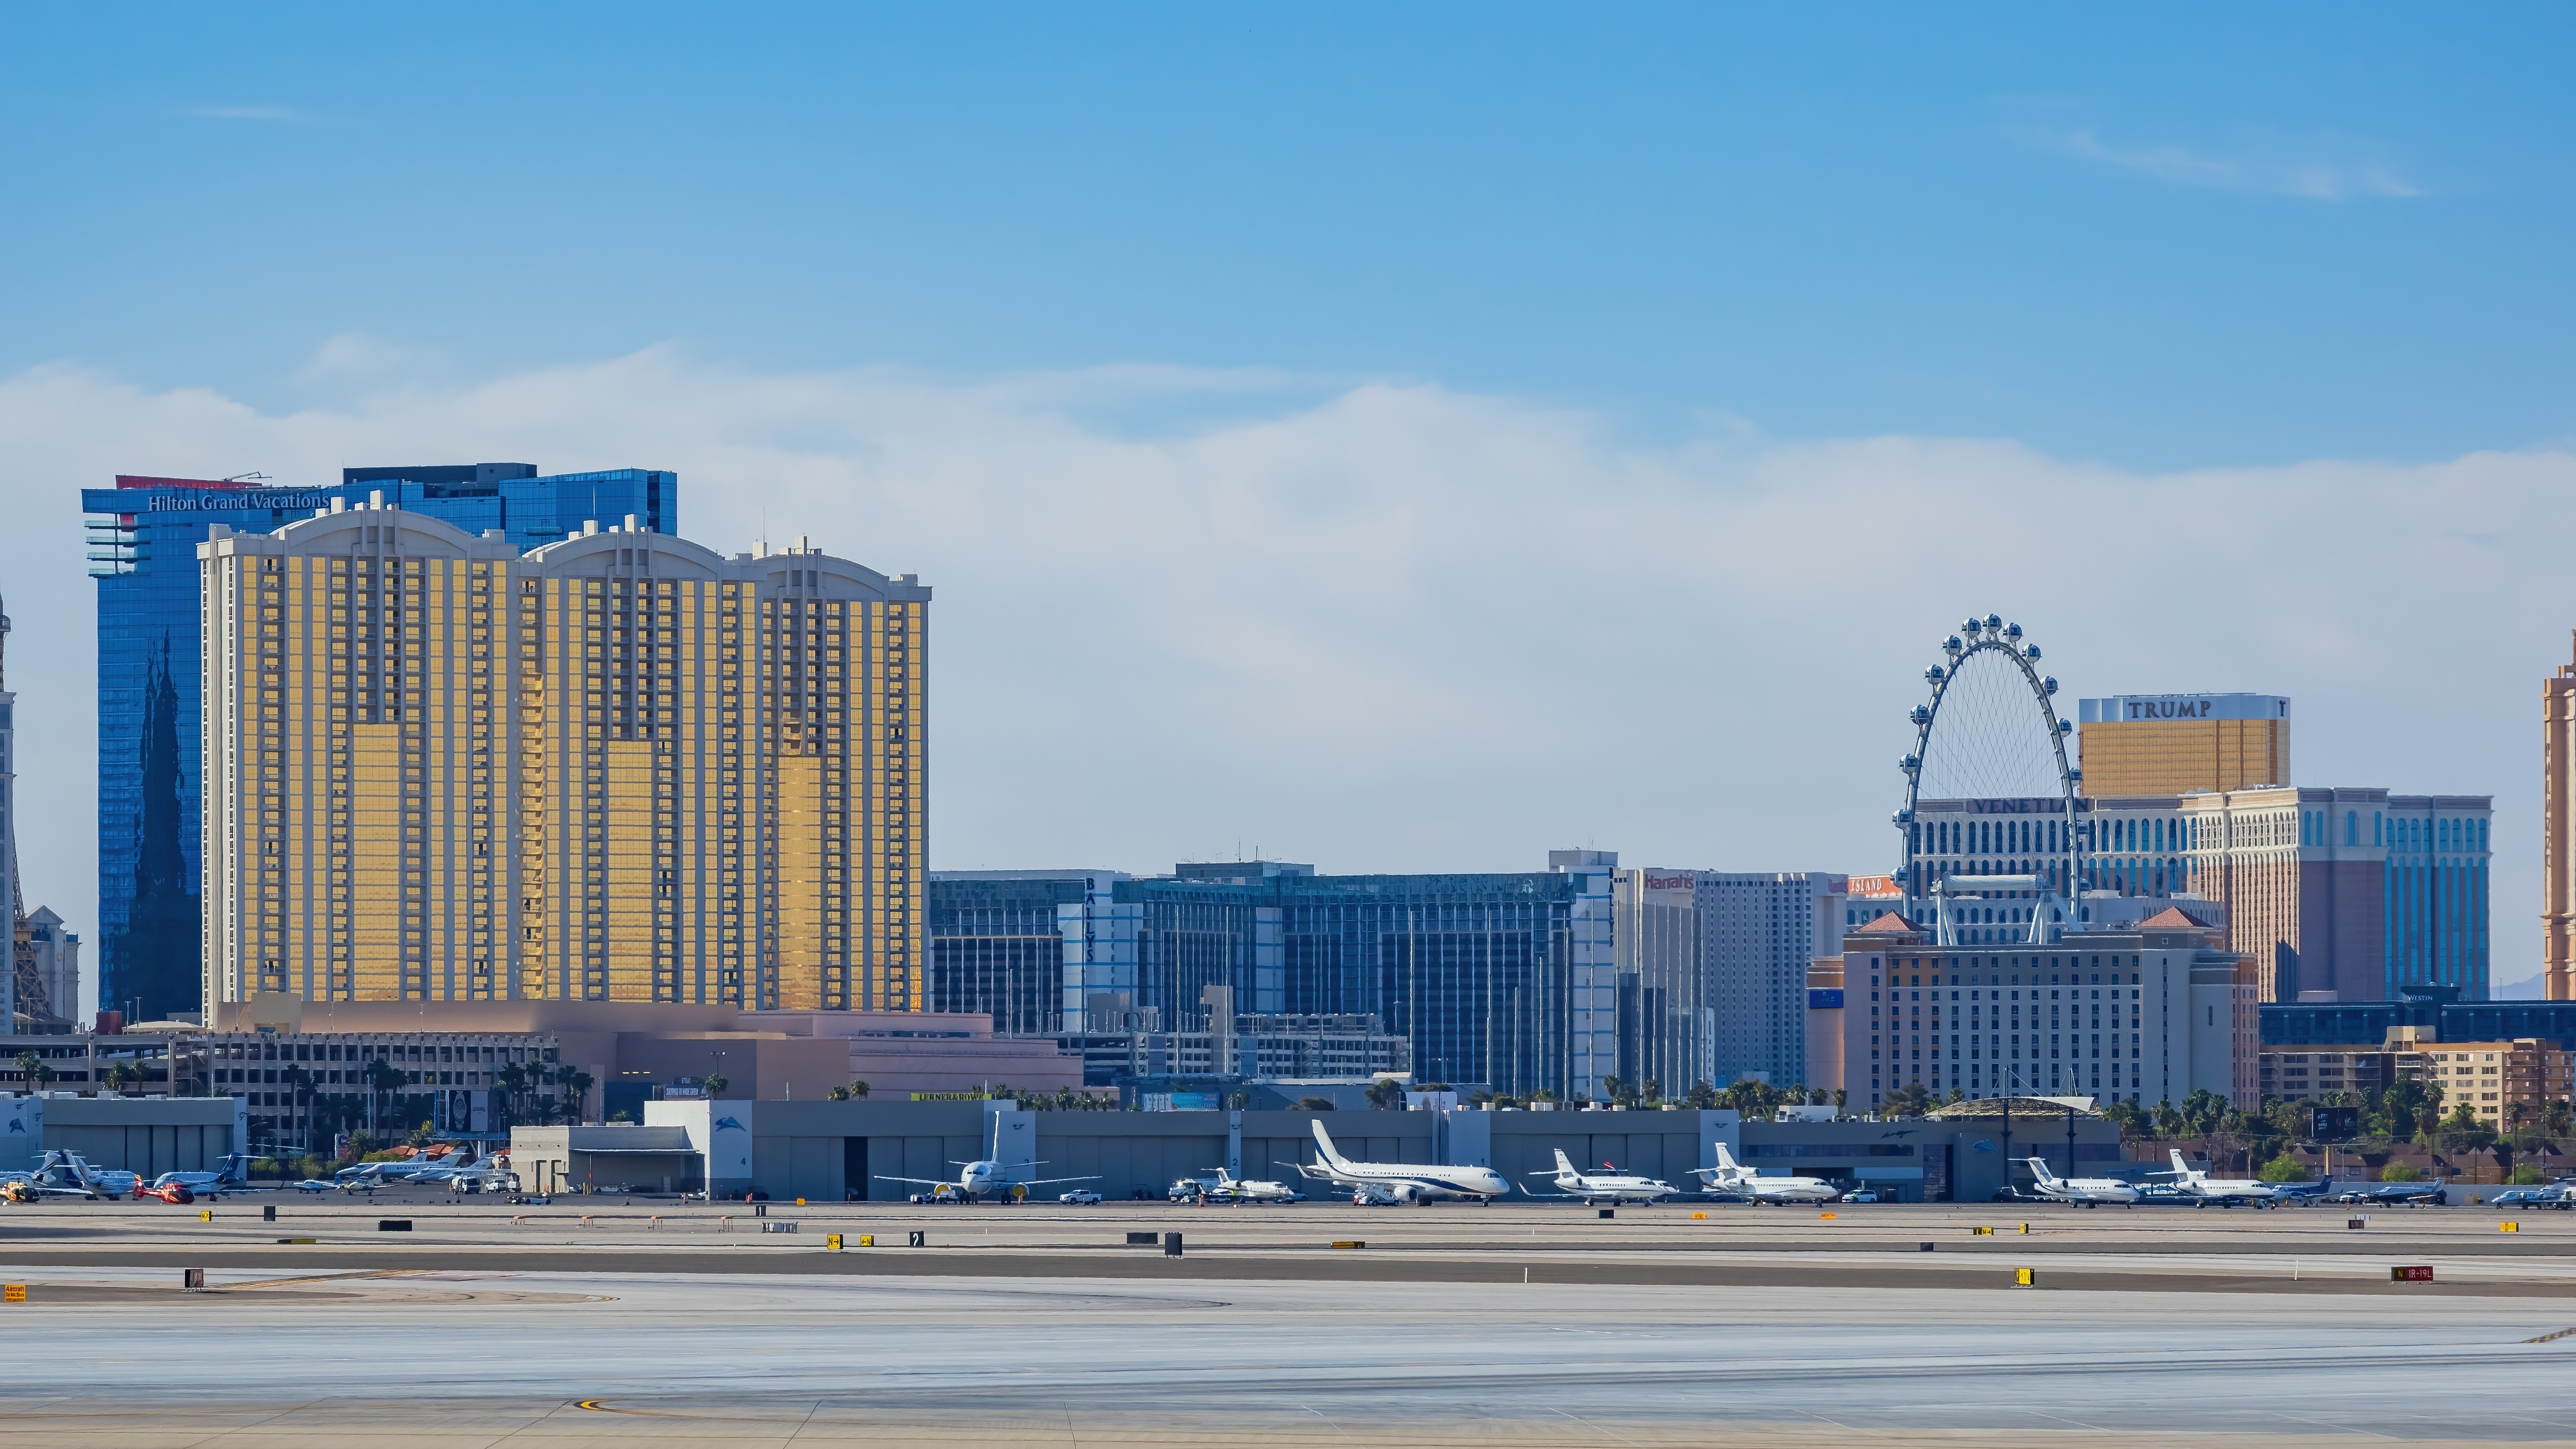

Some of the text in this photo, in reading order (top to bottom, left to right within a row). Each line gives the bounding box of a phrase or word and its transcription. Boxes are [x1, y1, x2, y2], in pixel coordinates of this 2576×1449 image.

[149, 492, 328, 511] Hilton Grand Vacations
[2128, 701, 2211, 718] TRUMP
[2279, 700, 2286, 717] T
[1851, 878, 1882, 892] ISLAND
[828, 1237, 833, 1246] N
[2409, 1269, 2431, 1278] 1R-19L
